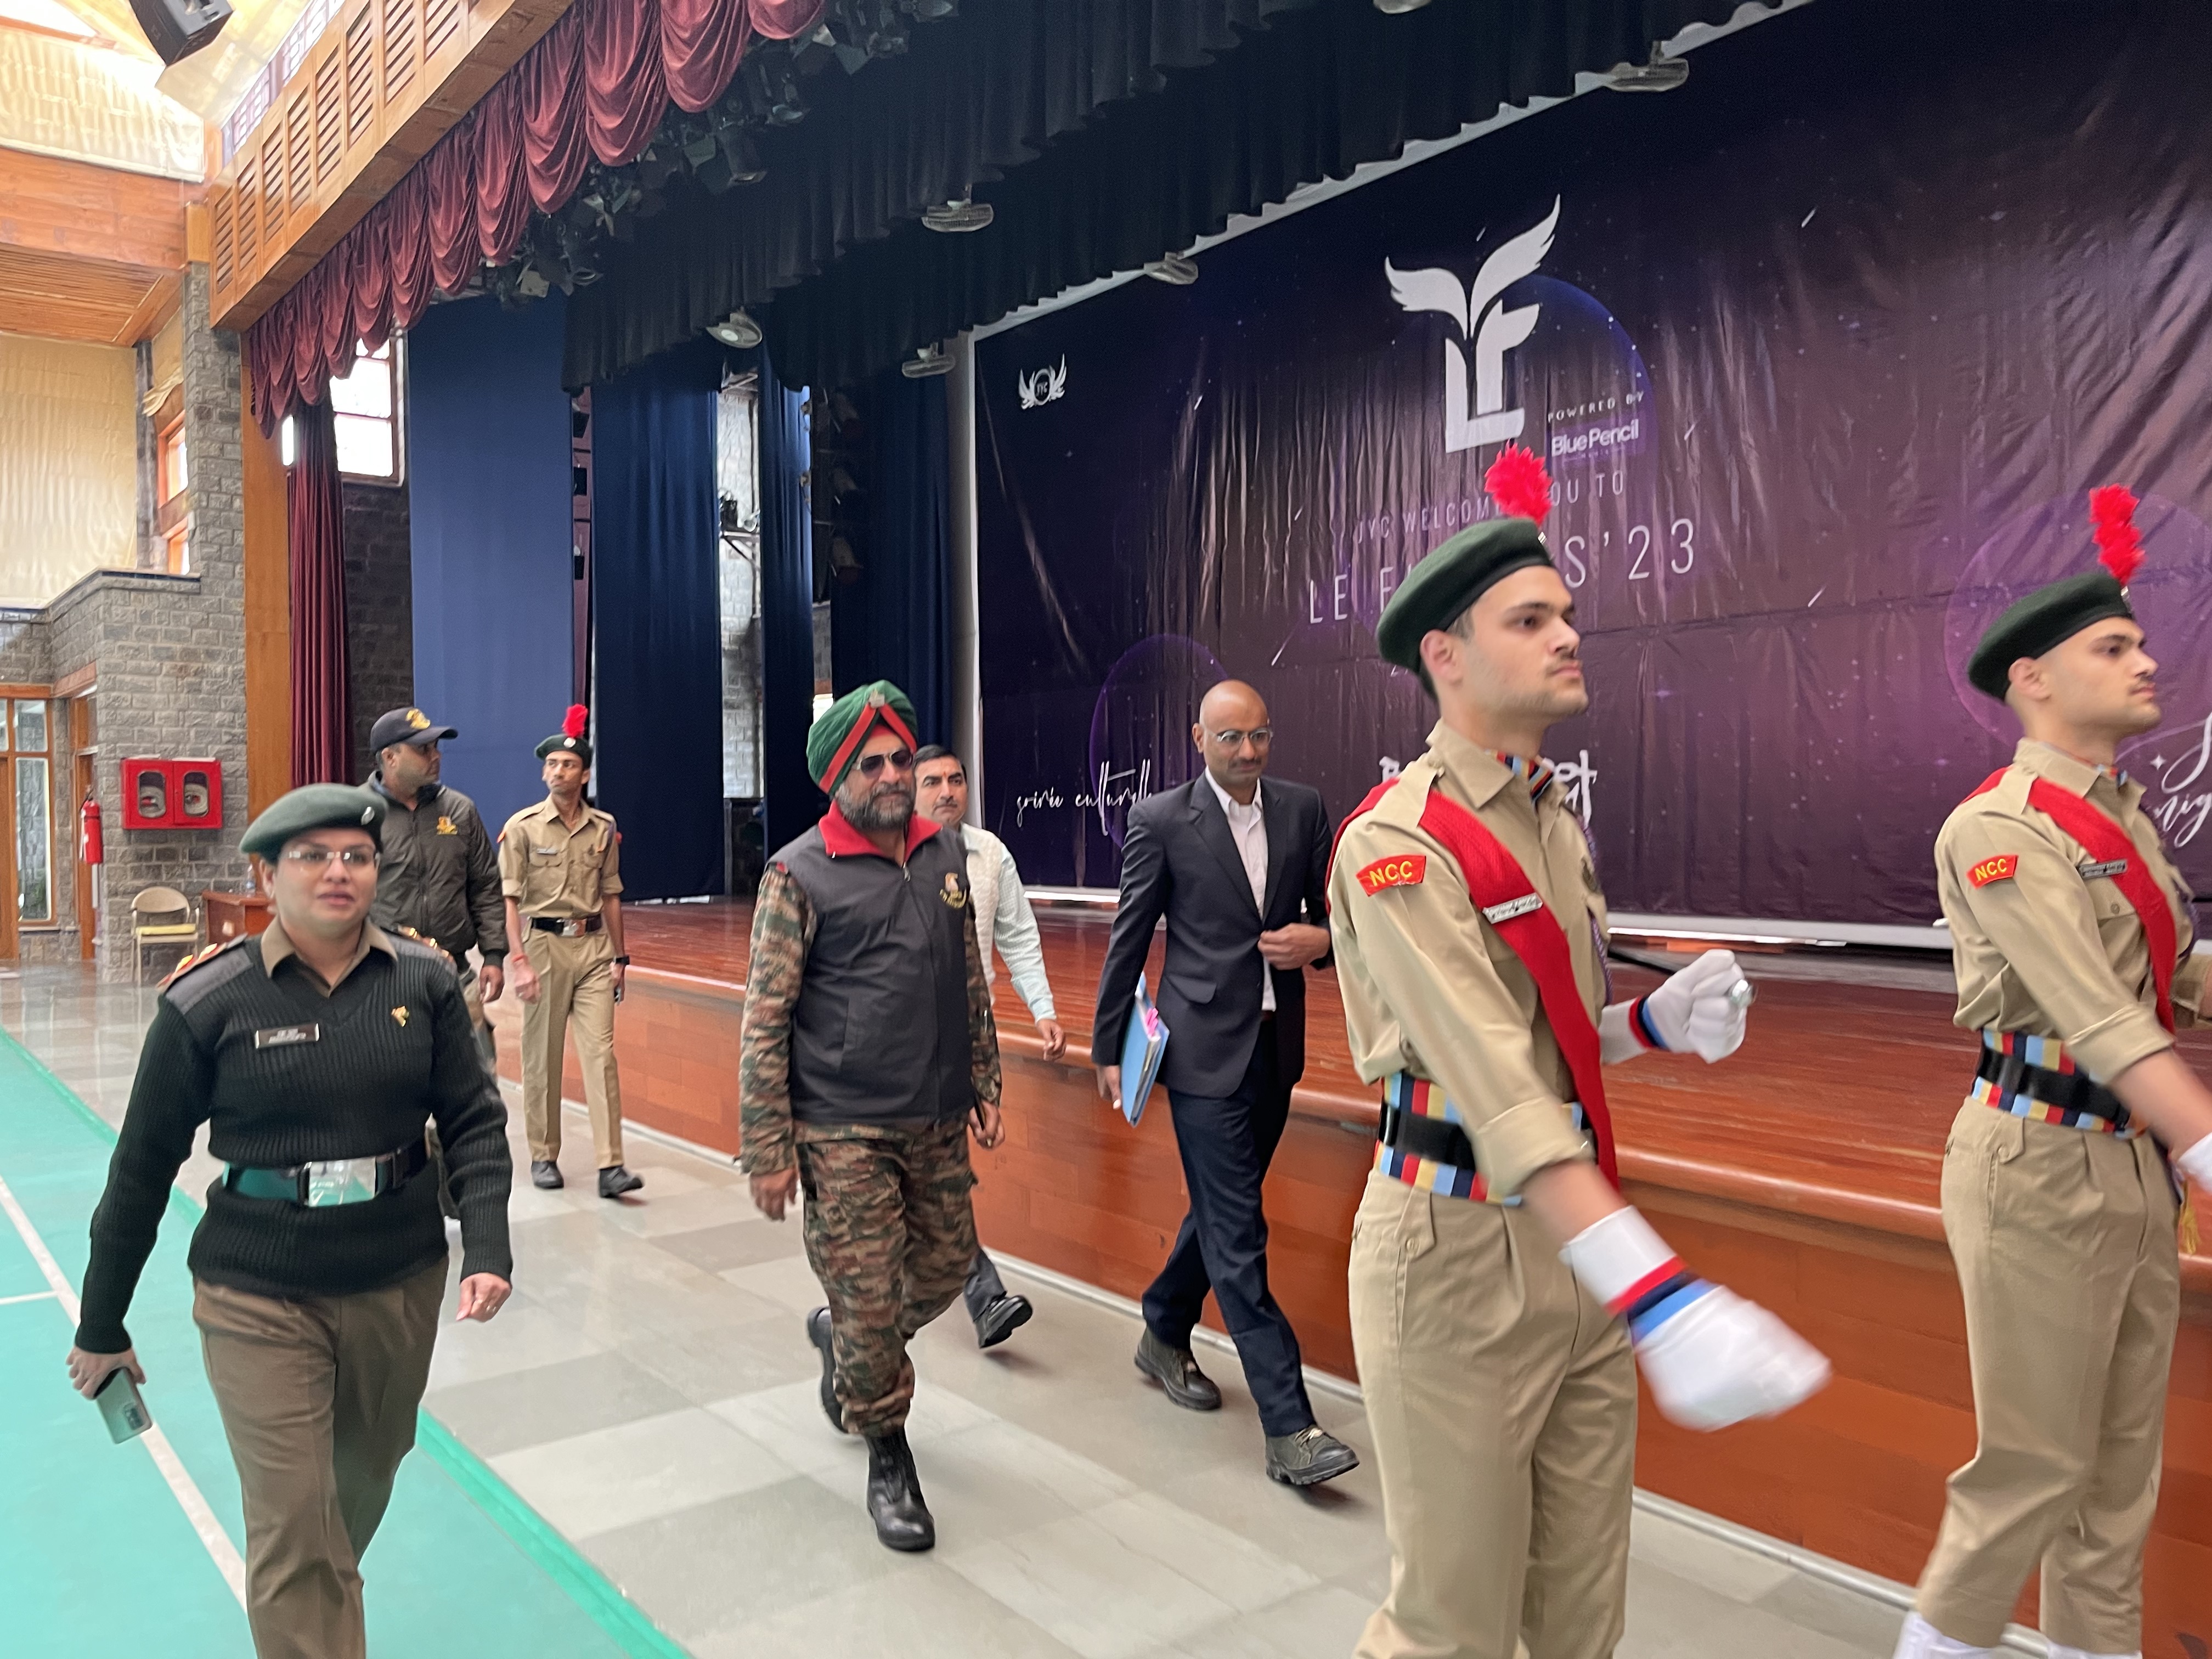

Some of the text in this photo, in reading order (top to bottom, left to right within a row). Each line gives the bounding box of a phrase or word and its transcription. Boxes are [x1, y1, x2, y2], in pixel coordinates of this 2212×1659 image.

[1402, 495, 1500, 533] WELCOM
[1550, 478, 1579, 507] OU
[1596, 470, 1624, 498] TO
[1310, 574, 1348, 624] LE
[1075, 758, 1152, 837] culturell
[1369, 860, 1413, 887] NCC
[1974, 858, 2007, 882] NCC
